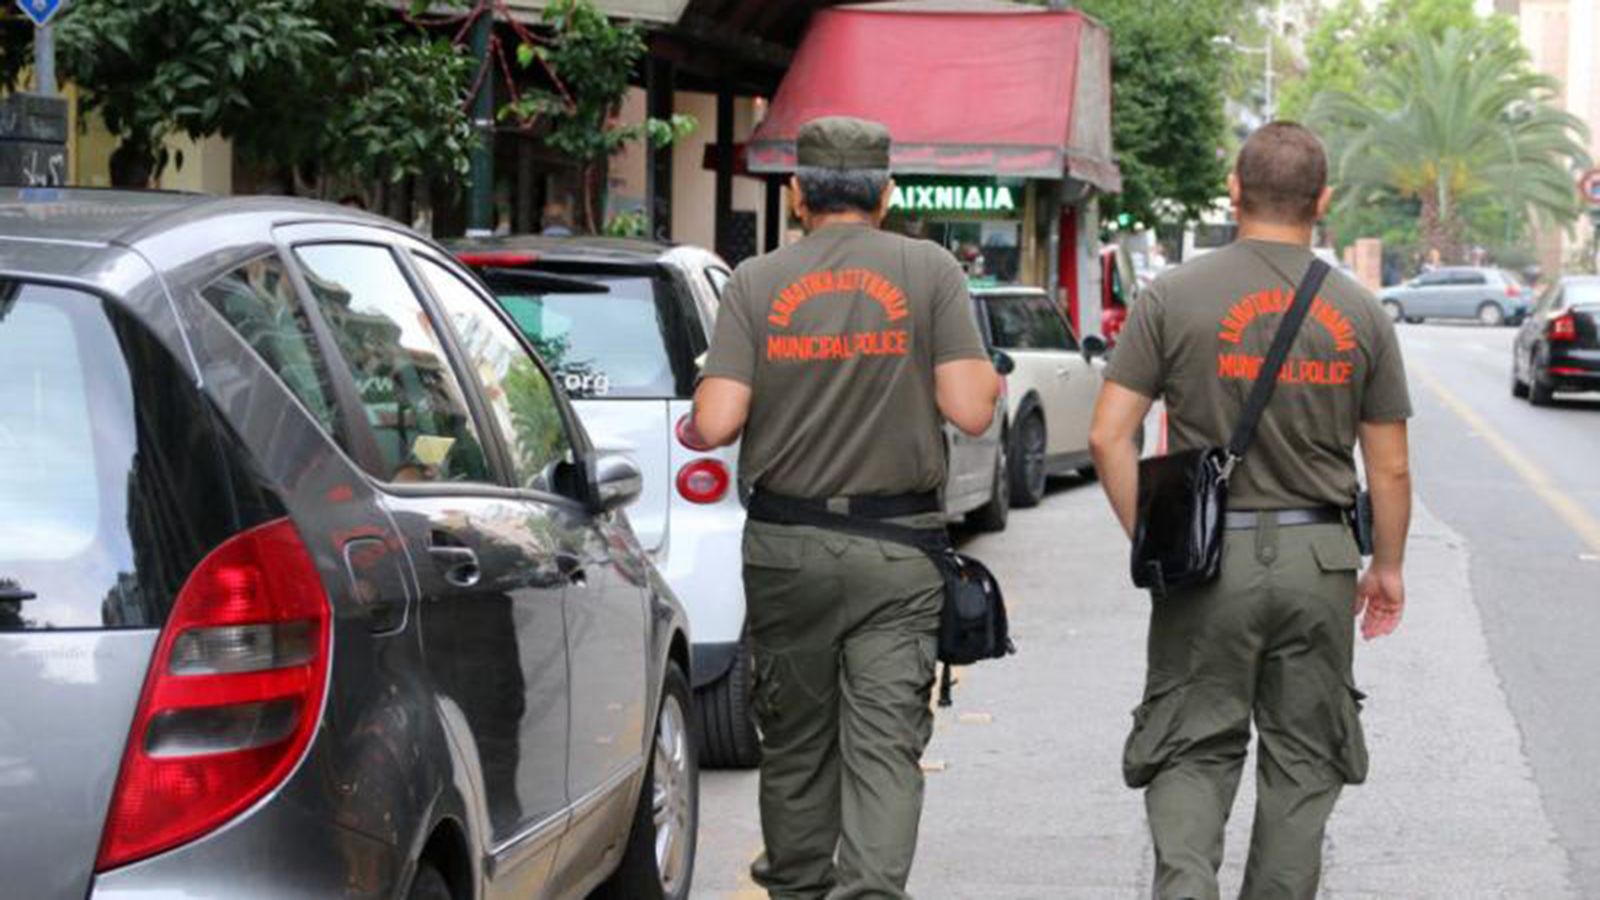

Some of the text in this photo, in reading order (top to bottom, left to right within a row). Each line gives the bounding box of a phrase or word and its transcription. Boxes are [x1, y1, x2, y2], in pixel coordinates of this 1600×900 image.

[767, 330, 908, 360] MUNICIPAL POLICE
[1301, 360, 1353, 384] POLICE
